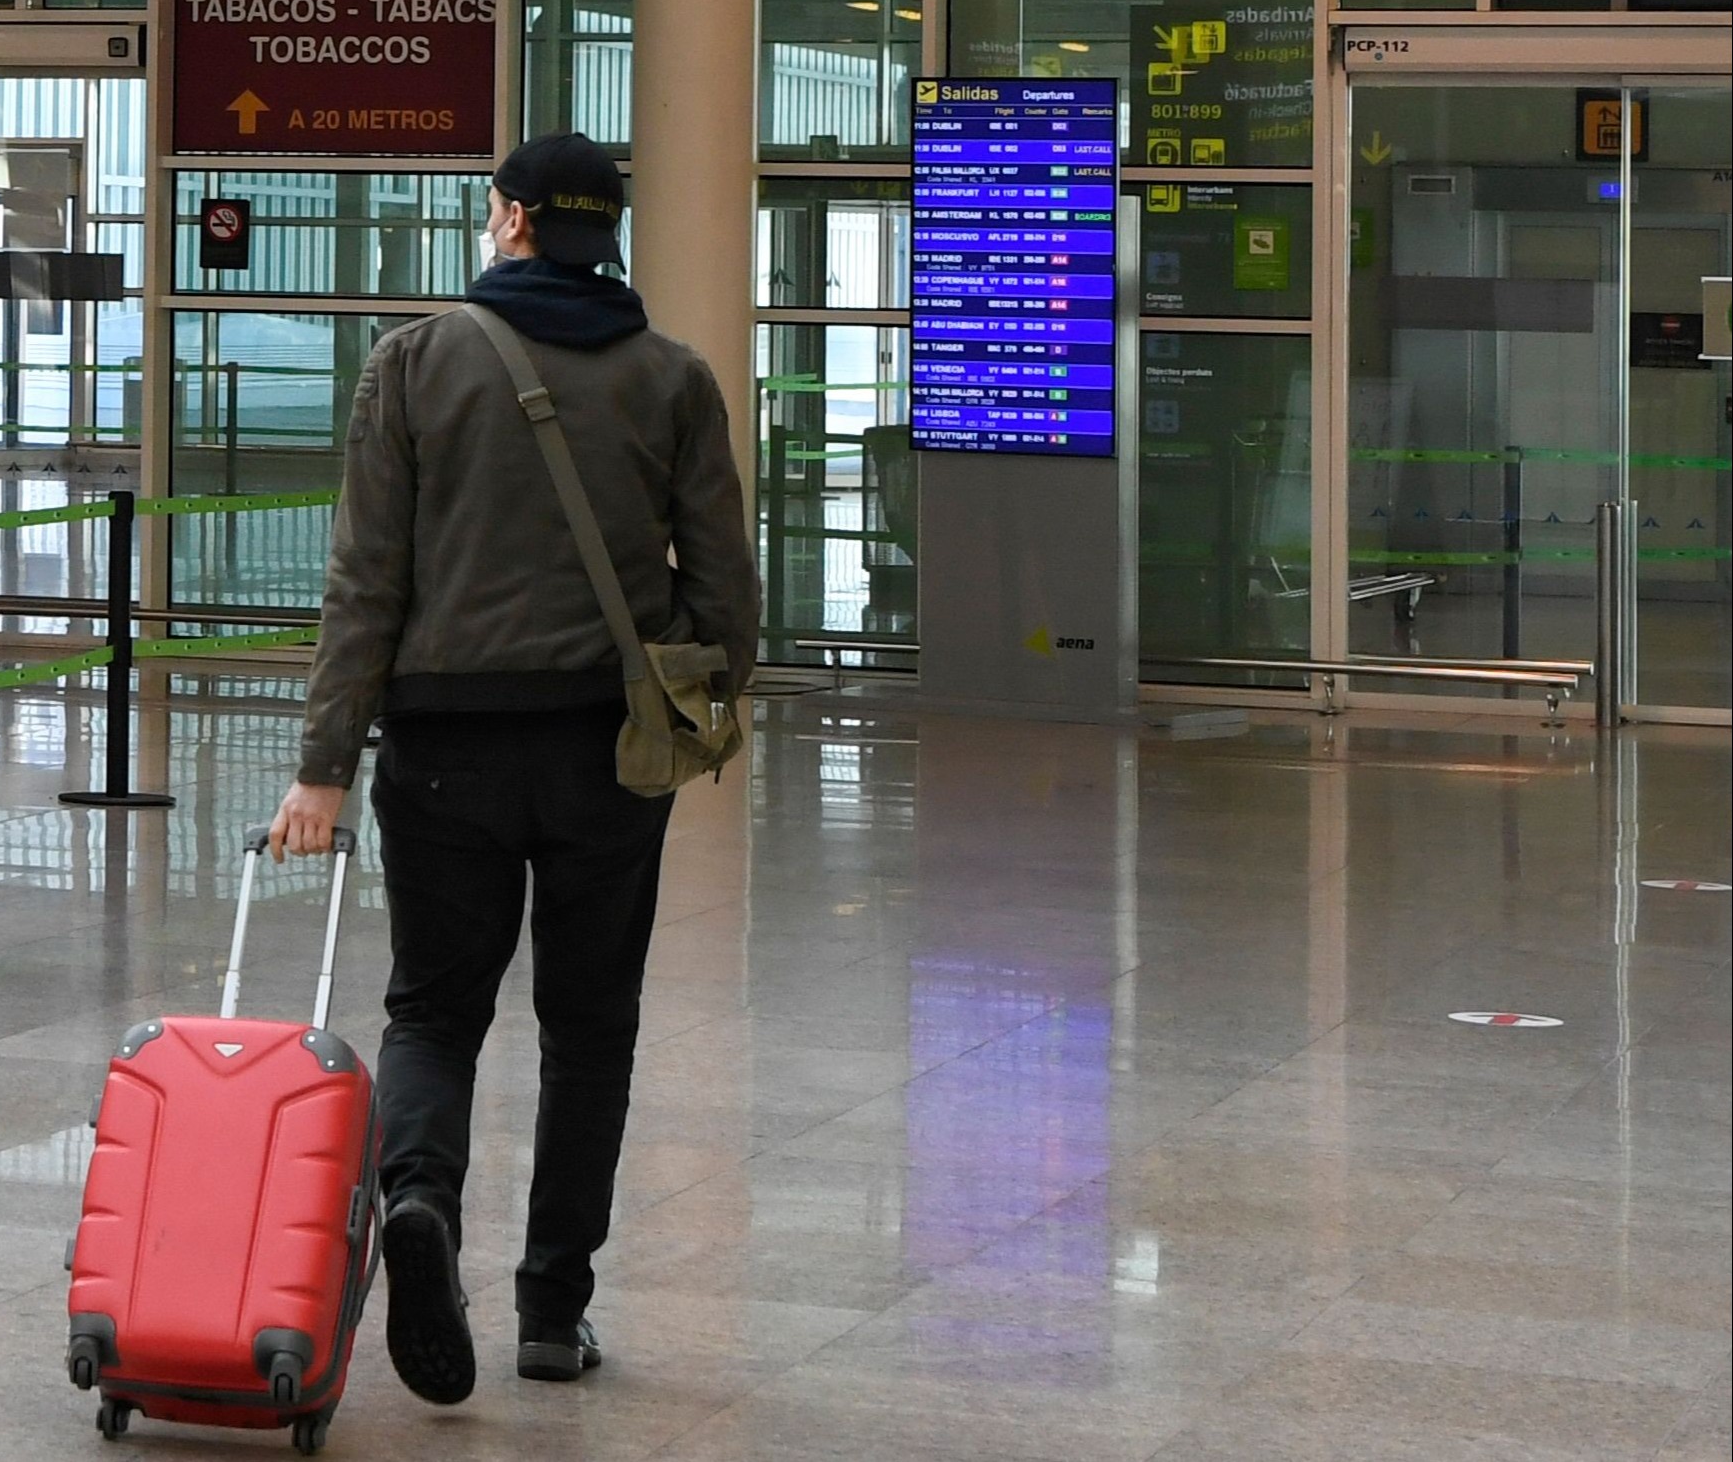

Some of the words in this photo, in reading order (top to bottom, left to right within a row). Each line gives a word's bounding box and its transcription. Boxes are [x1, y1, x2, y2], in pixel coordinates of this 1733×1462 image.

[248, 35, 431, 65] TOBACCOS
[1346, 40, 1409, 53] PCP-112
[941, 85, 999, 101] Salidas
[1022, 89, 1075, 101] Departures
[288, 110, 306, 130] A
[312, 109, 341, 130] 20
[348, 109, 455, 131] METROS
[1055, 637, 1095, 651] aena
